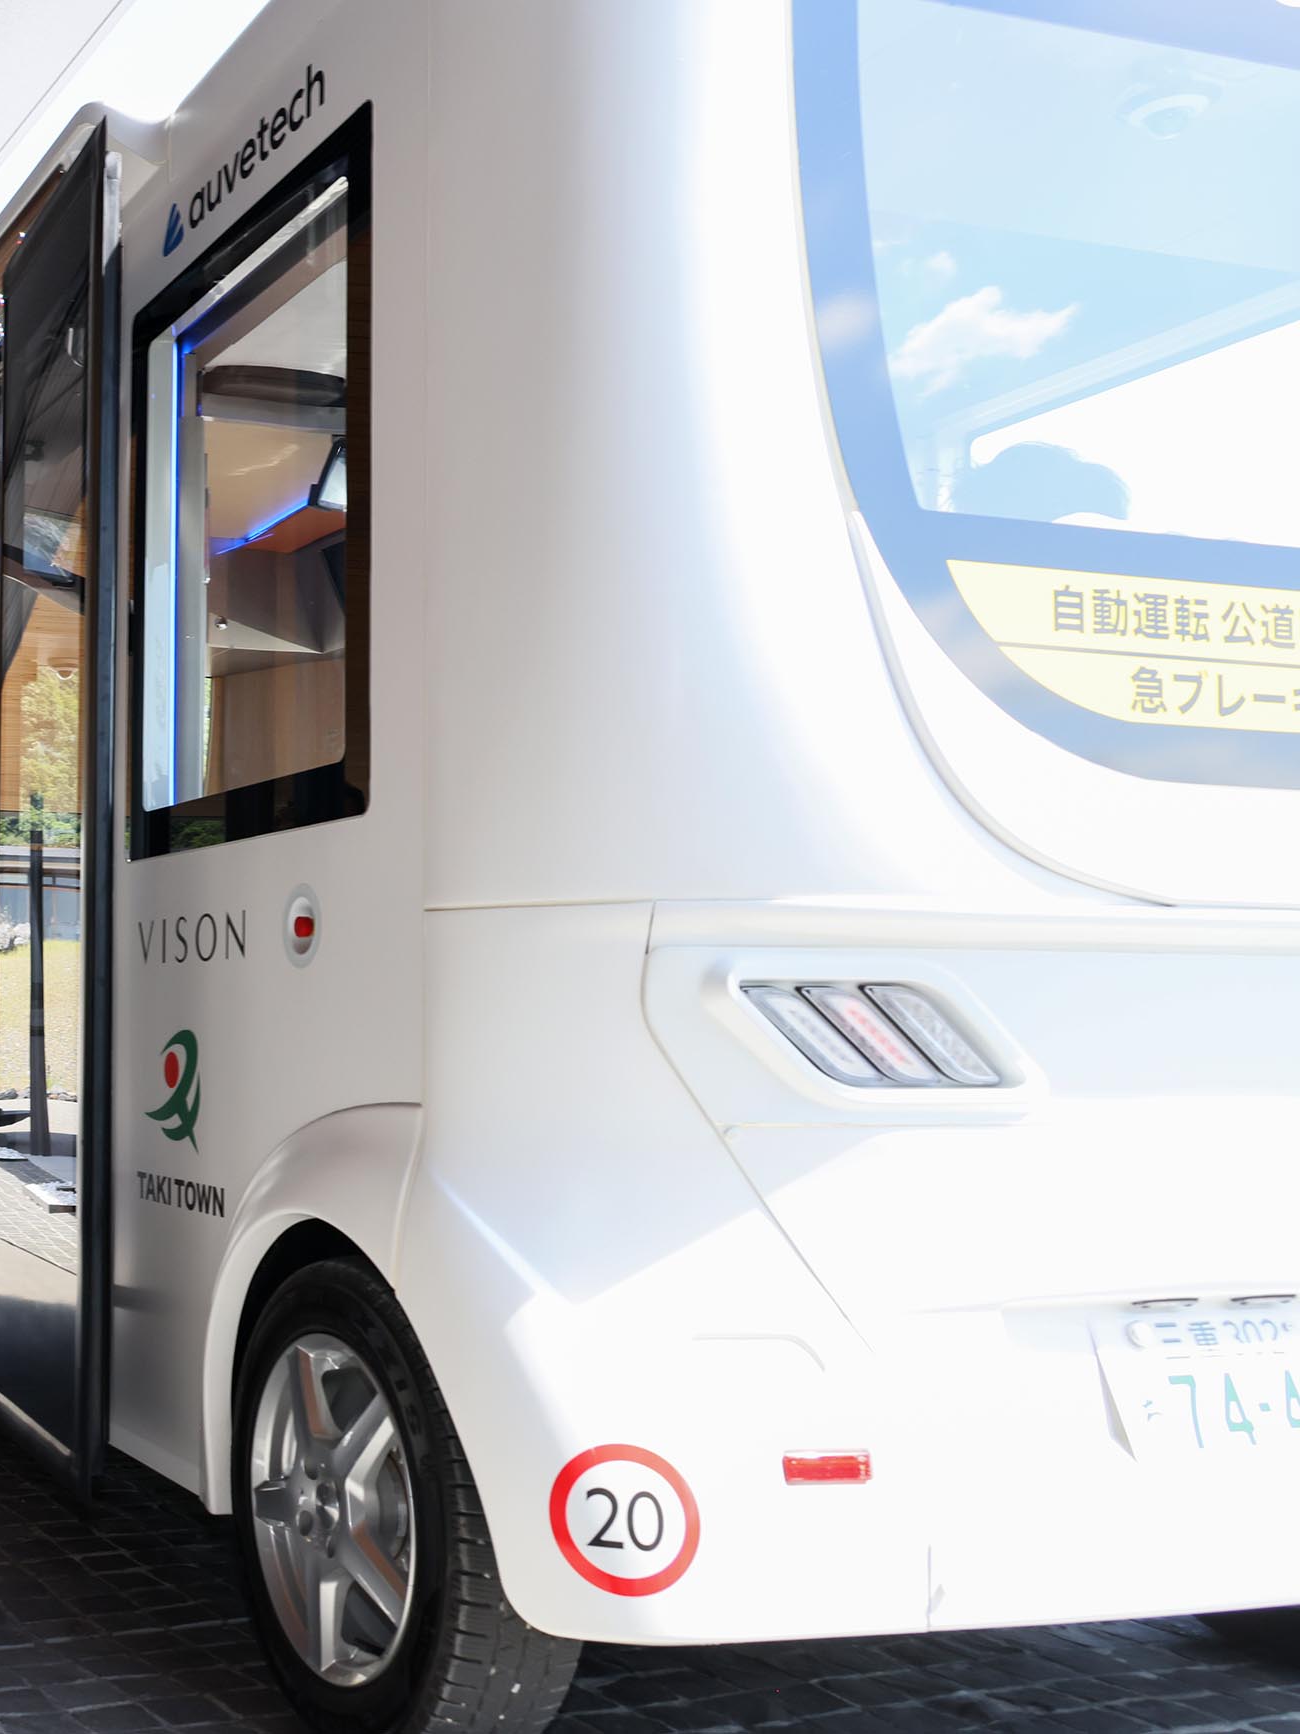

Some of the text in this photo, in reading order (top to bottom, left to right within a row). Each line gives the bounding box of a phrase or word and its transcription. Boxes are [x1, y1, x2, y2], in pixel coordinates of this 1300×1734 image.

[188, 63, 325, 229] auvetech
[1131, 666, 1300, 718] 急ブレー
[138, 909, 246, 965] VISON
[136, 1170, 225, 1218] TAKI TOWN
[585, 1487, 664, 1552] 20
